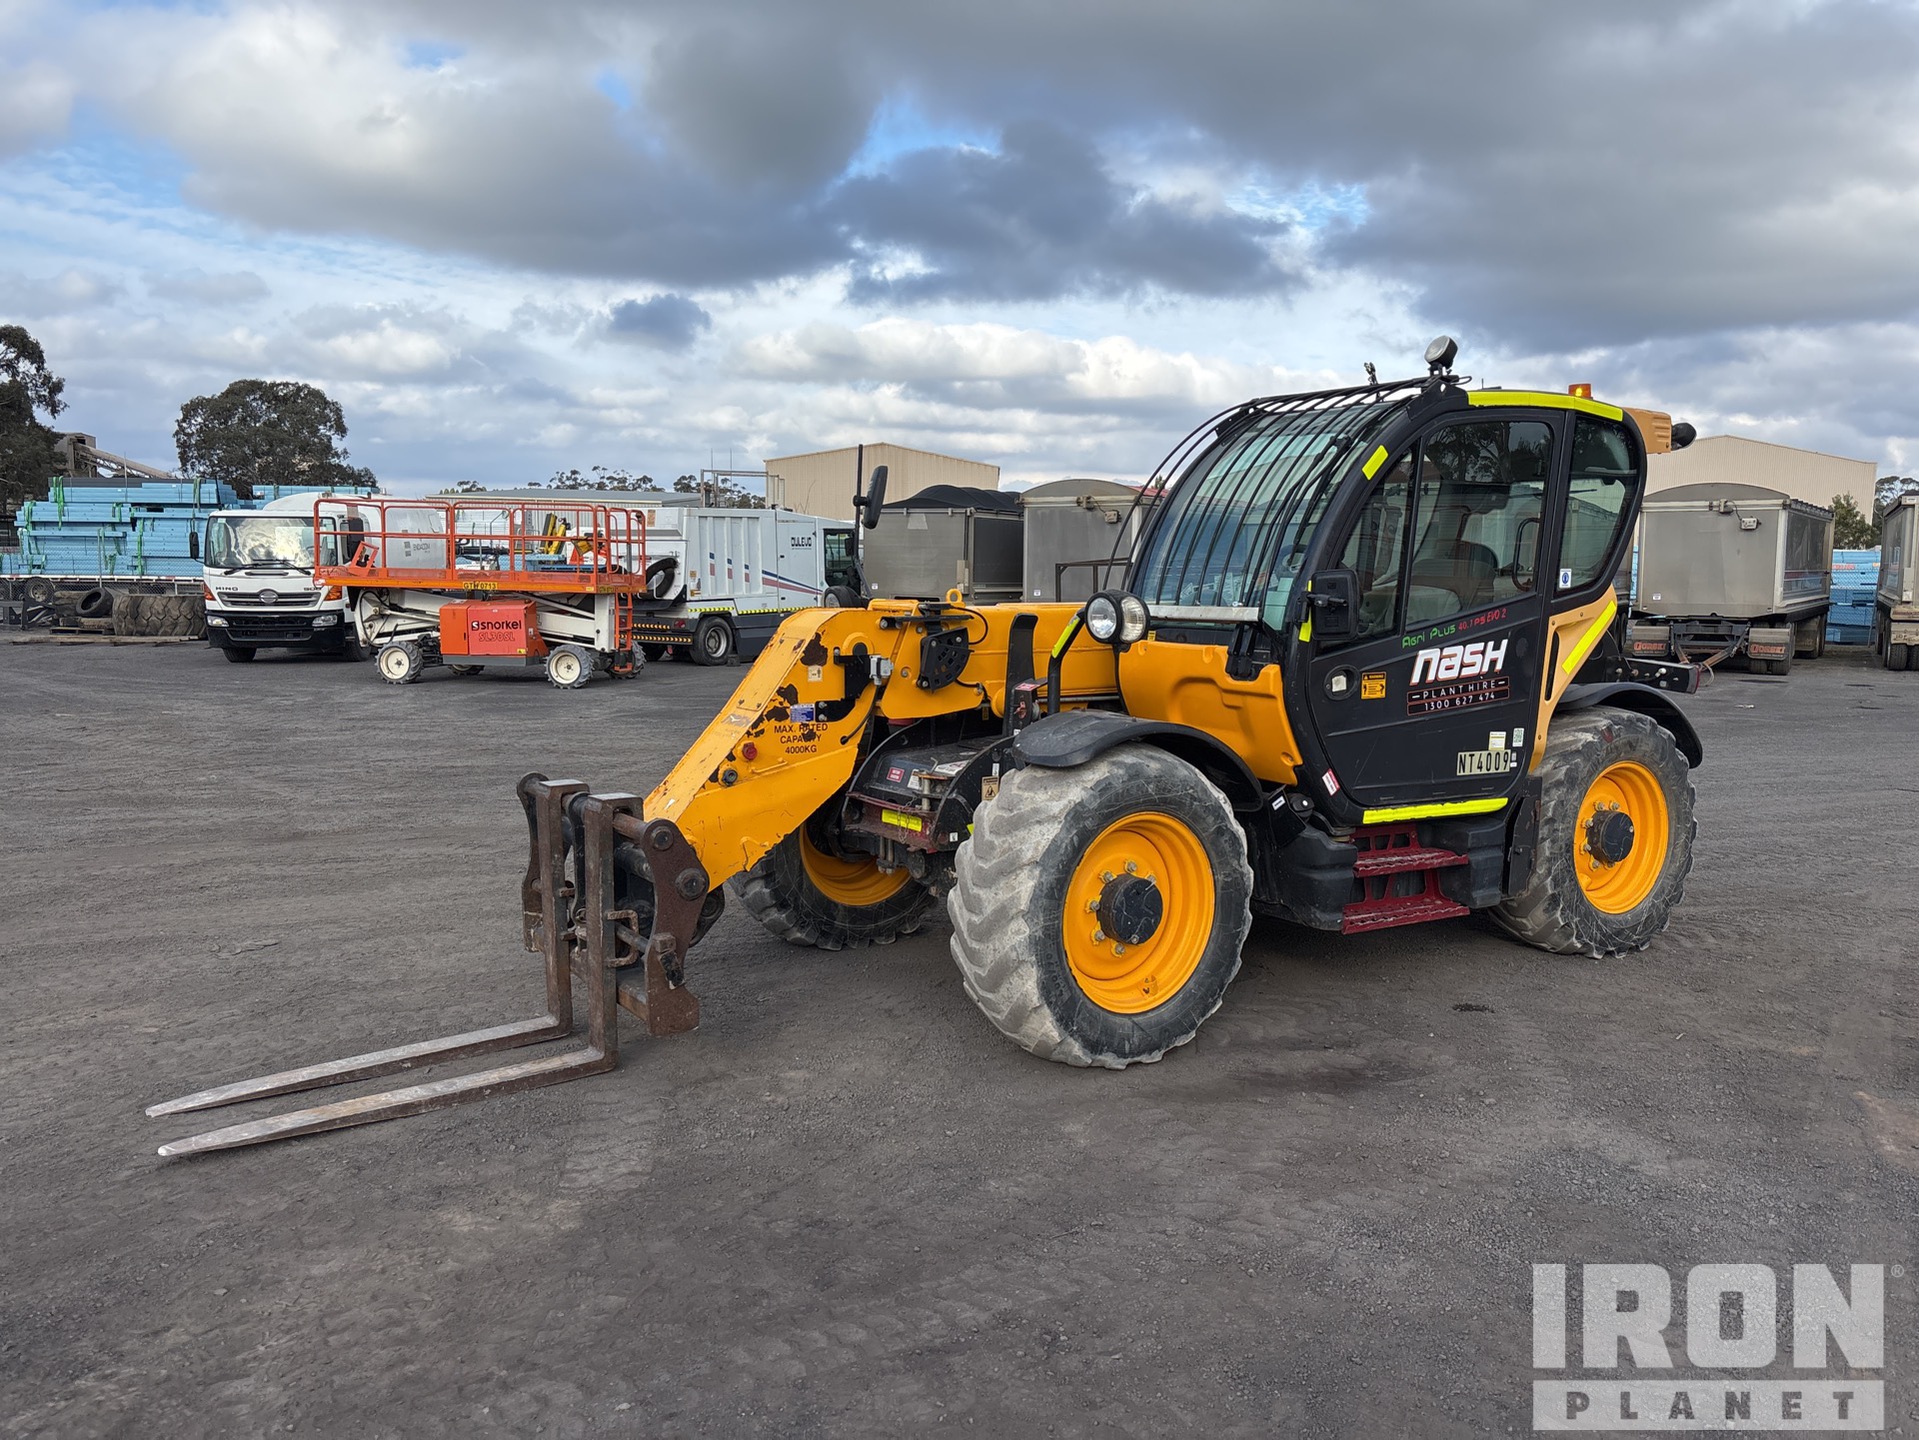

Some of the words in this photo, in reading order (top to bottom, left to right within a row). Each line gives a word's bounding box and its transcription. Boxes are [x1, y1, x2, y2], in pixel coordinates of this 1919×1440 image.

[480, 620, 522, 630] snorkel
[1422, 685, 1464, 700] PLANT
[1468, 679, 1496, 692] HIRE
[1424, 699, 1450, 711] 1300
[1455, 695, 1473, 706] 627
[1478, 691, 1495, 701] 474
[773, 724, 797, 733] MAX.
[780, 733, 822, 744] CAPAY
[785, 744, 817, 754] 4000KG
[1458, 751, 1510, 773] NT4009
